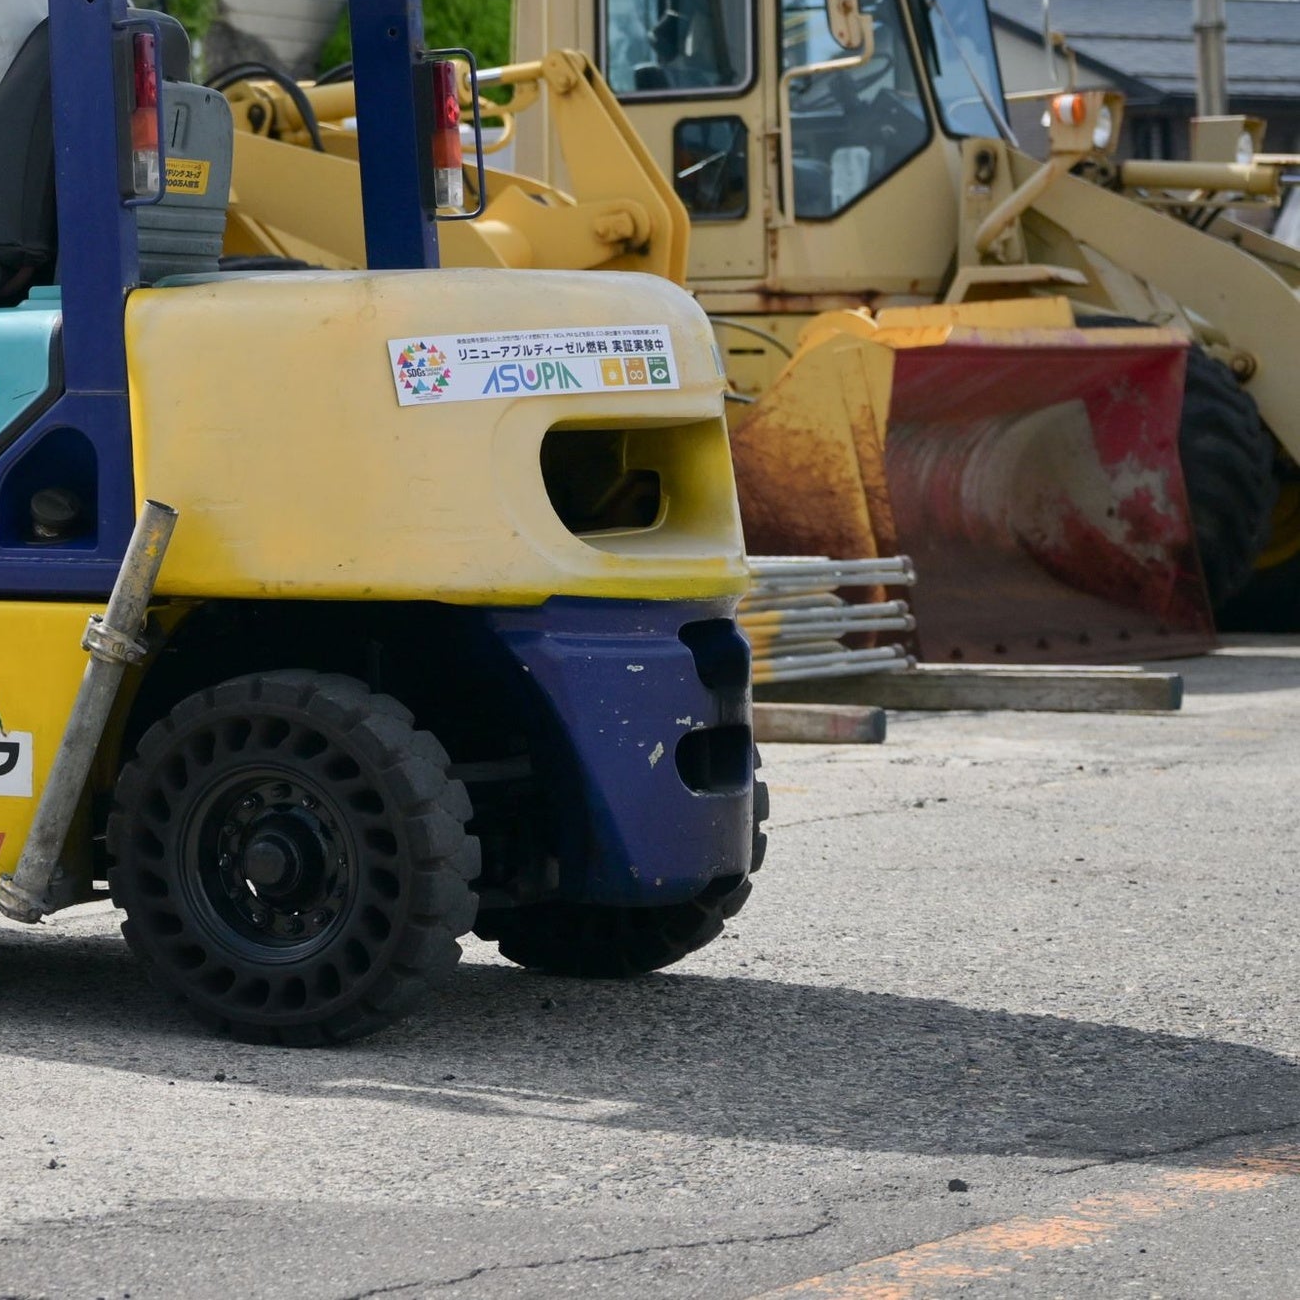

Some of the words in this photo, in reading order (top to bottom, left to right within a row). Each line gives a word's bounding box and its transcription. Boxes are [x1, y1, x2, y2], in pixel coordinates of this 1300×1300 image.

[459, 341, 608, 361] リニューアブルディーゼル燃料
[612, 339, 664, 354] 実証実験中
[407, 367, 426, 378] SDGs
[482, 361, 582, 394] ASUPIA
